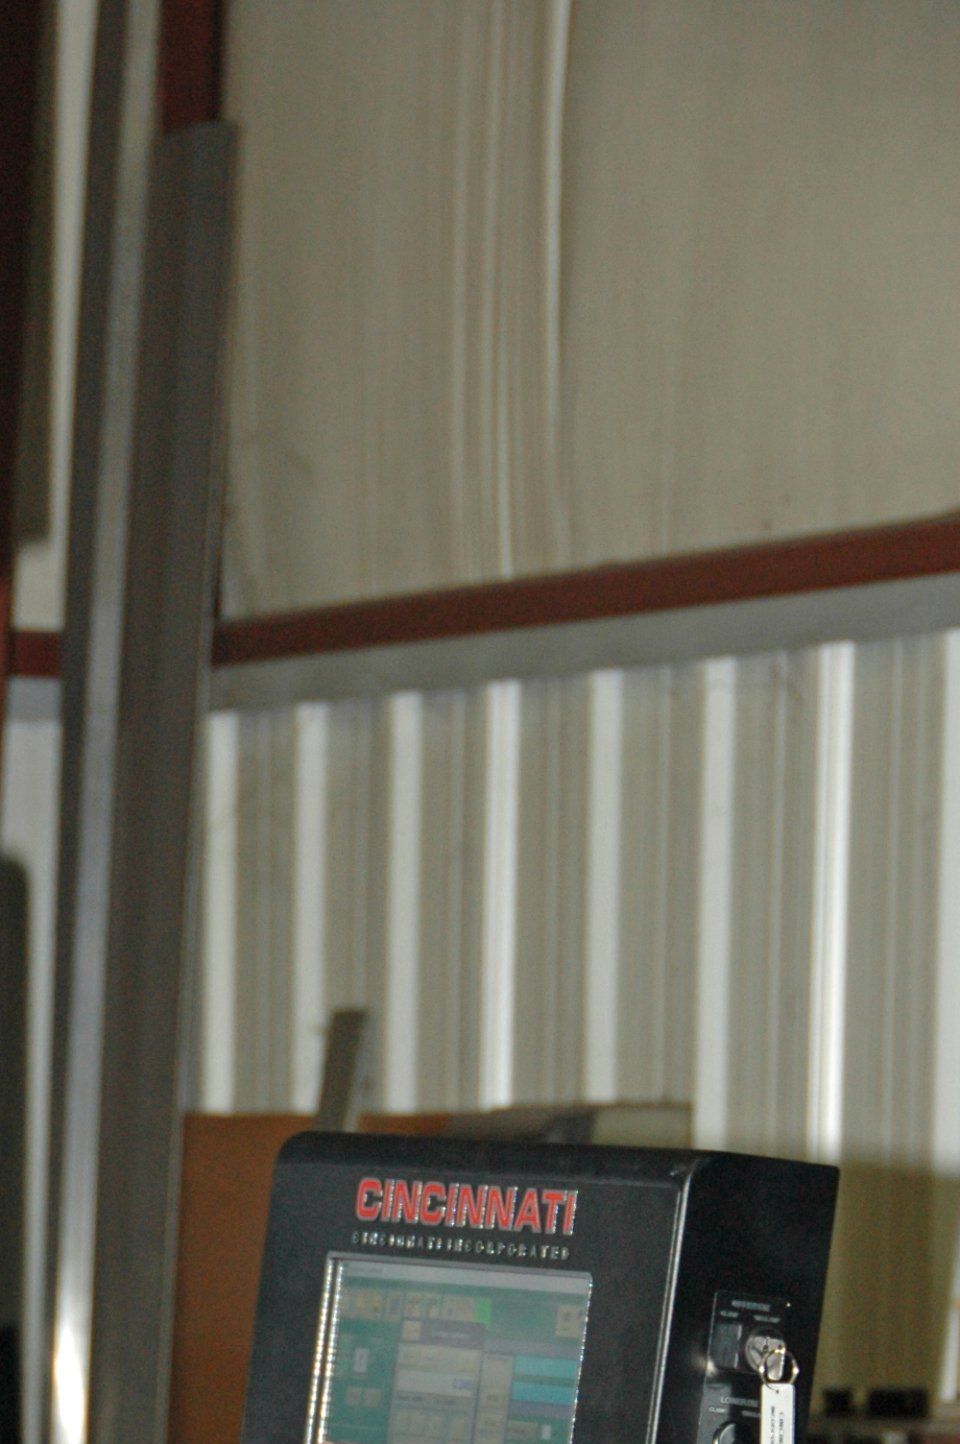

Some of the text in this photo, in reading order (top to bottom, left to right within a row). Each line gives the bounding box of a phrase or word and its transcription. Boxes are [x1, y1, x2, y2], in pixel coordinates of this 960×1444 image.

[355, 1177, 579, 1236] CINCINNATI
[351, 1230, 570, 1260] CINCINNATI INCORPORATED
